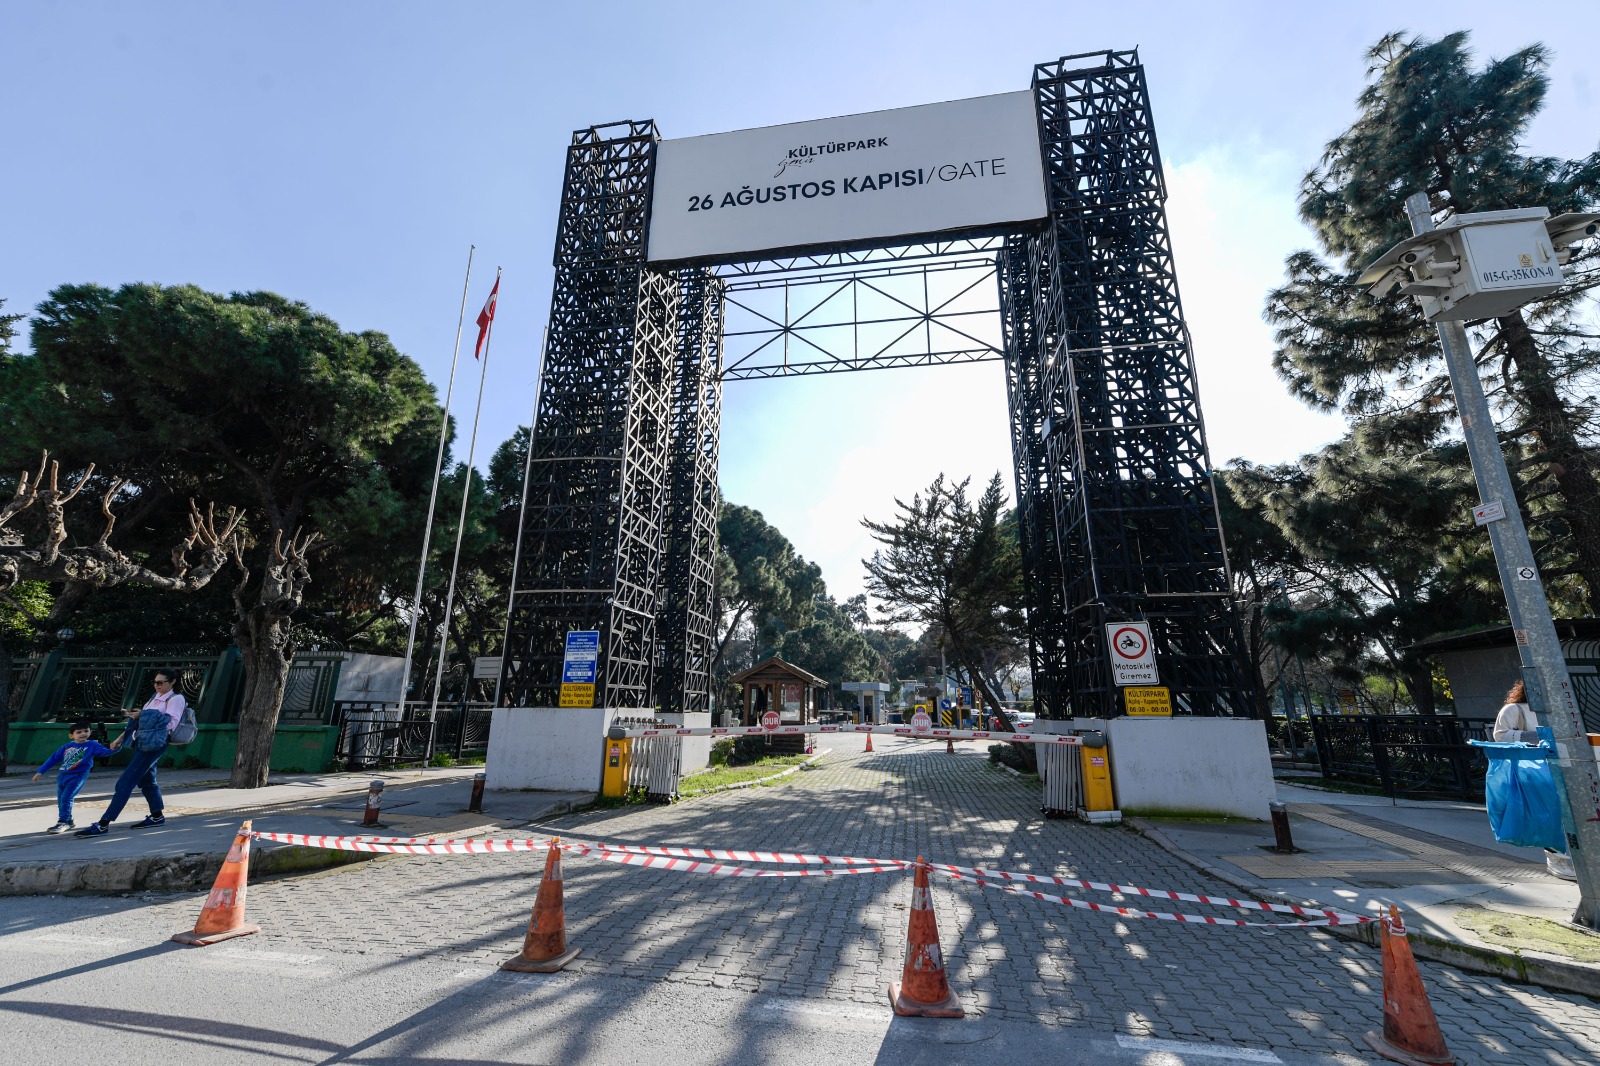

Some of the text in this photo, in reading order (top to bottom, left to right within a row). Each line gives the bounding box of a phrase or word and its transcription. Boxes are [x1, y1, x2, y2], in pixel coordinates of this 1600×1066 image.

[788, 137, 888, 159] KÜLTÜRPARK
[688, 194, 713, 213] 26
[720, 180, 836, 209] AĞUSTOS
[1483, 266, 1554, 283] 015-G-35KON-0
[764, 717, 779, 725] DUR
[914, 719, 929, 727] DUR
